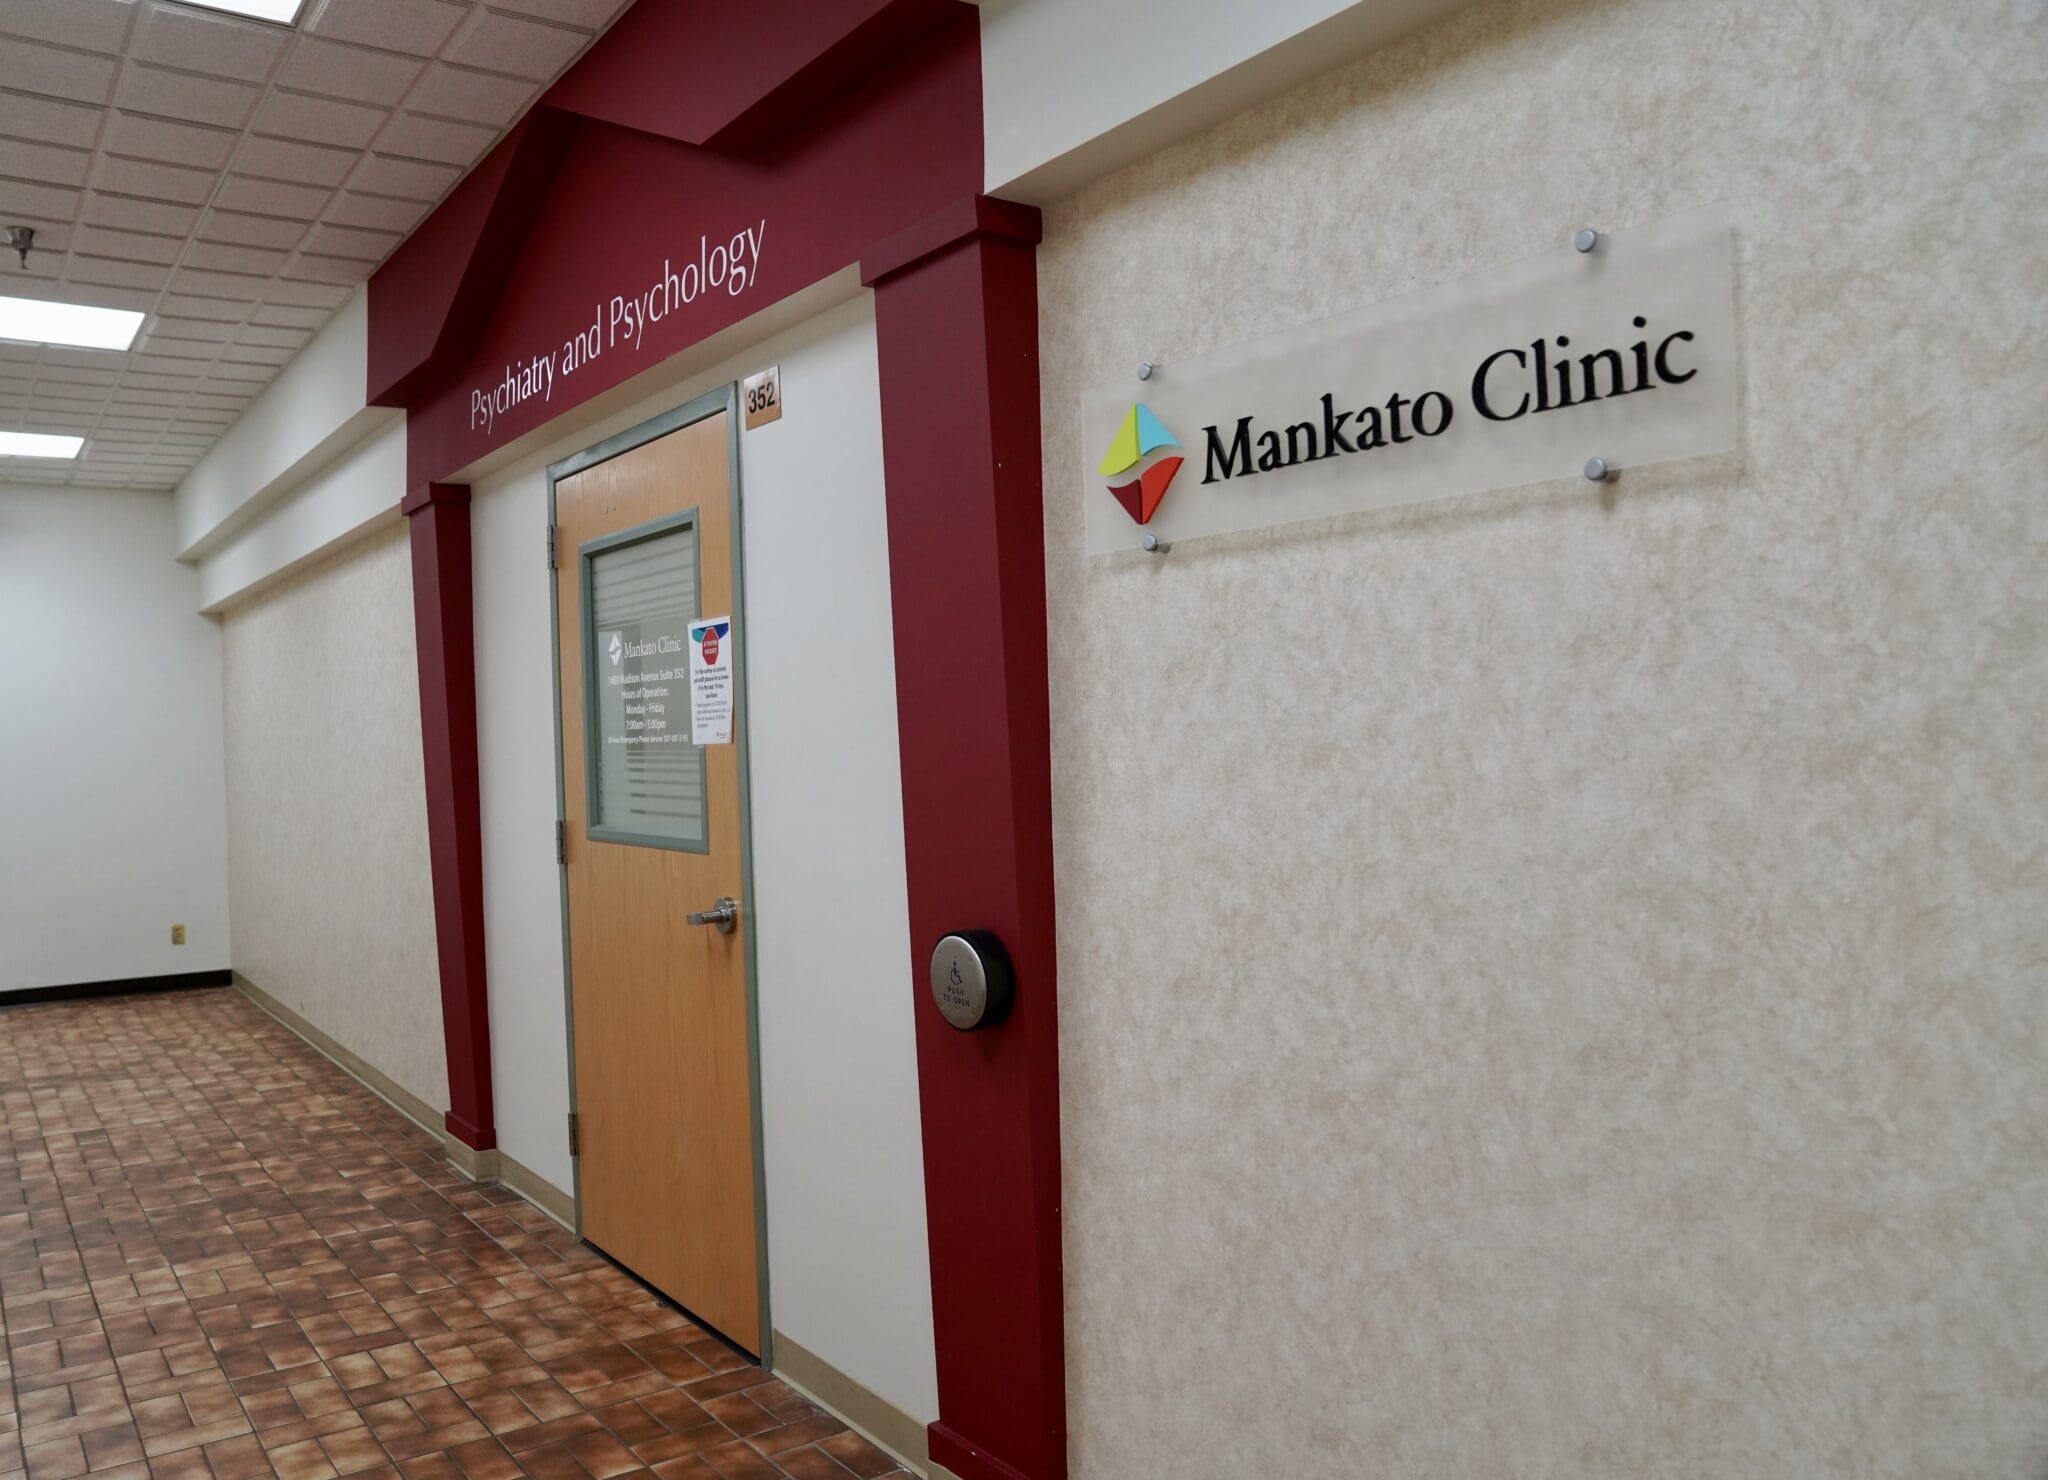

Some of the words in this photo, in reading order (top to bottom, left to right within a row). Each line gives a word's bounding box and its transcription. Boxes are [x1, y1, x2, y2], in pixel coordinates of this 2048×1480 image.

[470, 350, 557, 435] Psychiatry
[562, 304, 602, 376] and
[609, 219, 766, 350] Psychology
[748, 381, 776, 414] 352
[1199, 390, 1453, 485] Mankato
[1471, 314, 1698, 421] Clinic
[624, 640, 657, 659] Mankato
[658, 634, 682, 654] Clinic
[620, 673, 640, 684] Madison
[641, 672, 659, 683] Avenue
[660, 669, 673, 681] Suite
[674, 667, 684, 679] 352
[622, 690, 636, 700] Hours
[637, 688, 642, 698] of
[642, 686, 670, 700] Operation:
[626, 704, 645, 716] Monday
[649, 702, 665, 715] Friday
[948, 986, 965, 996] PUSH
[943, 993, 951, 1002] TO
[953, 996, 970, 1007] OPEN
